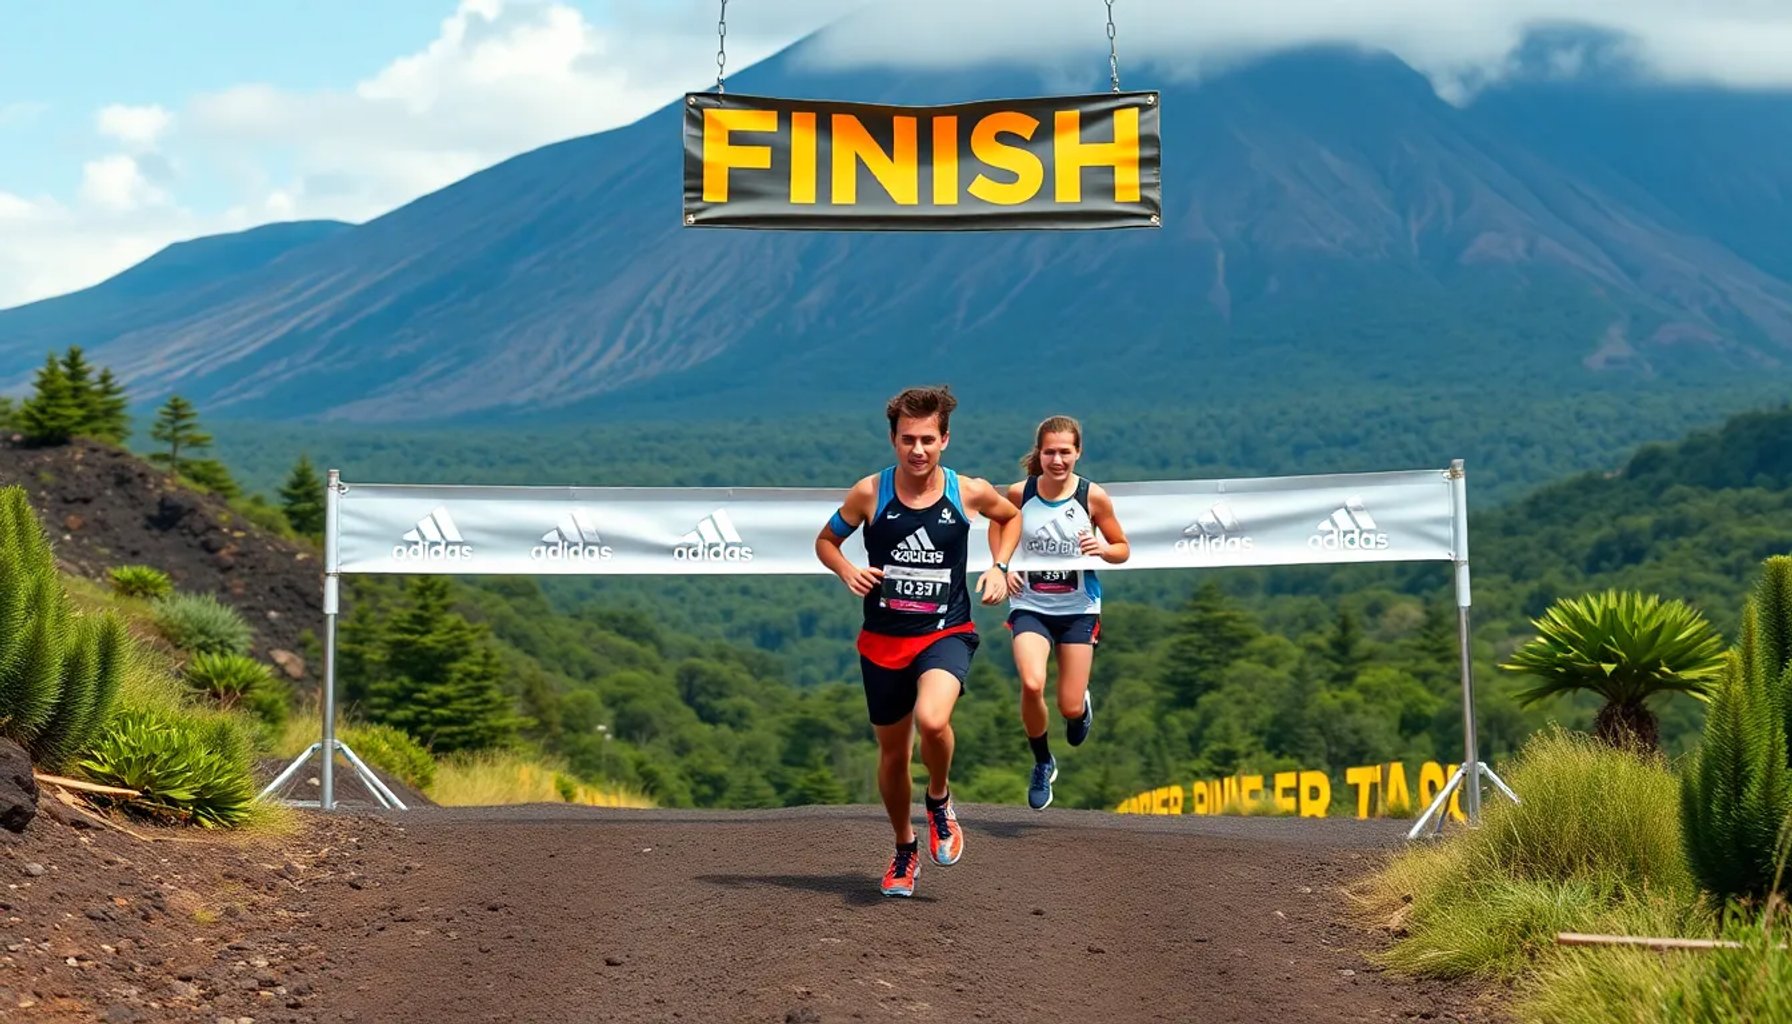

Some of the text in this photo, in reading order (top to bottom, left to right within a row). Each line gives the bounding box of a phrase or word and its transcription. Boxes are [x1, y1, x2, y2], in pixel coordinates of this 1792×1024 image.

[702, 107, 1140, 205] FINISH
[1174, 532, 1254, 554] adidas
[1307, 528, 1390, 550] adidas
[392, 541, 473, 561] adidas
[530, 541, 613, 562] adidas
[673, 541, 753, 562] adidas
